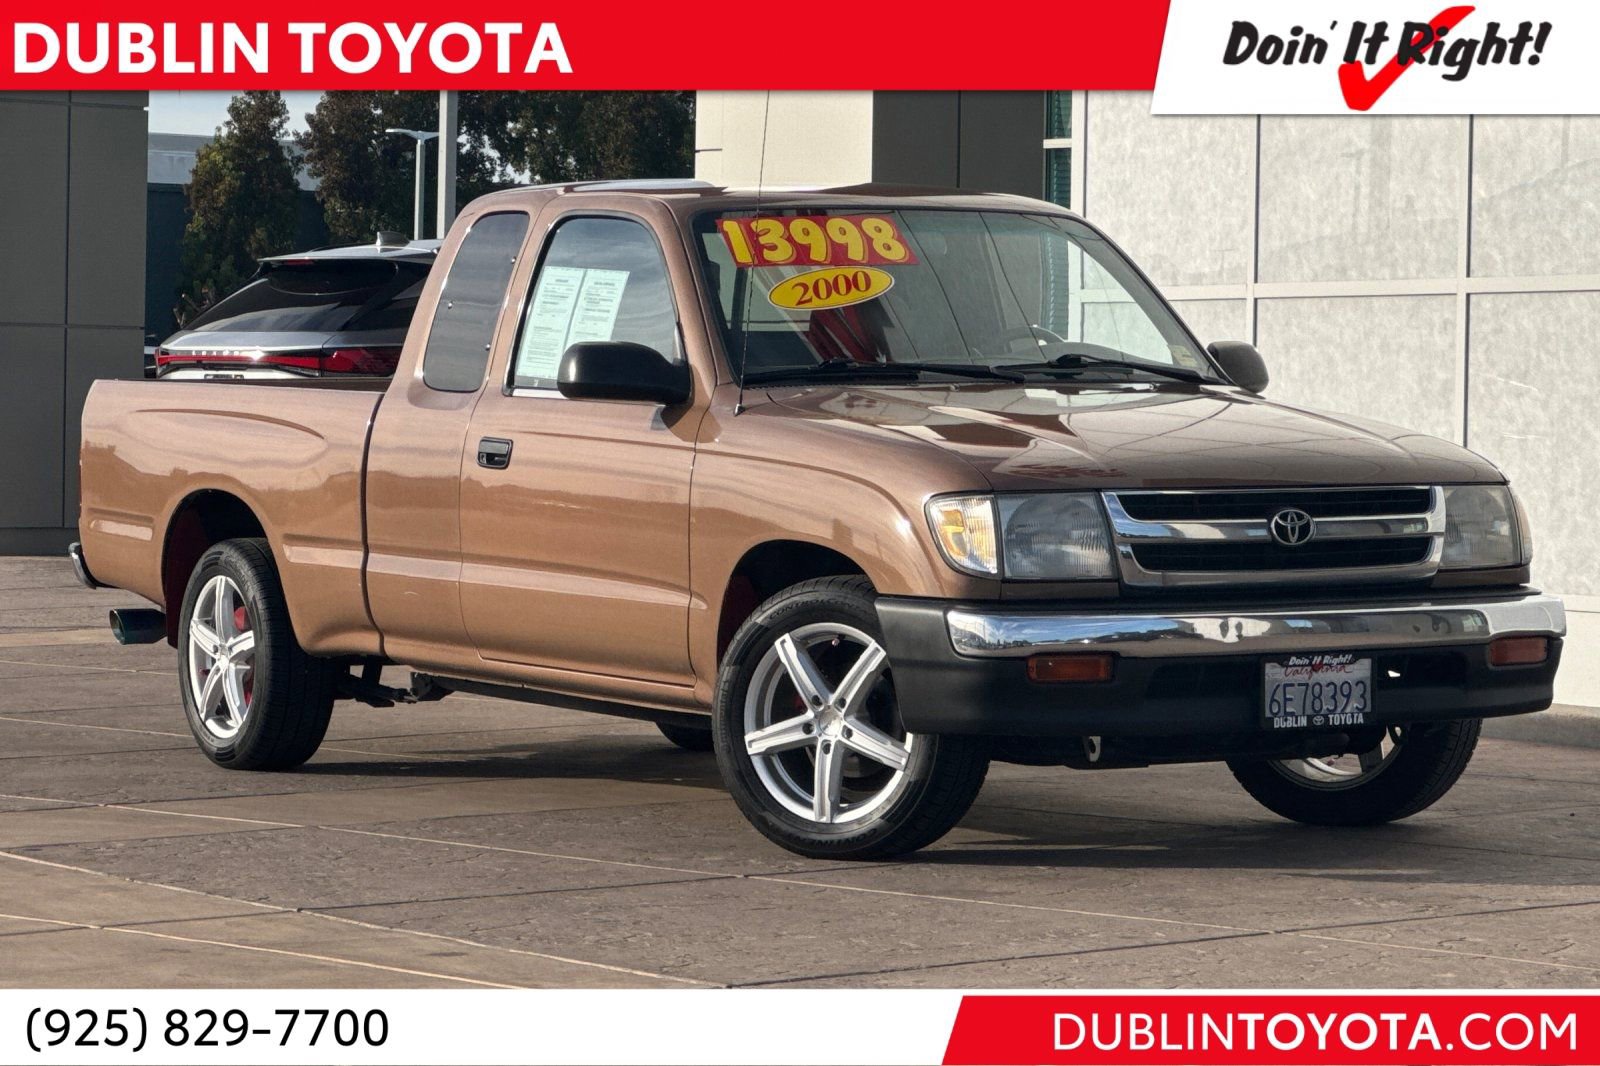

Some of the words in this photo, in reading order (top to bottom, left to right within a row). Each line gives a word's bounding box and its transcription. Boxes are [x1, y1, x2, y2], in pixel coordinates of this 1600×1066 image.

[722, 217, 910, 264] 13998
[791, 270, 872, 307] 2000
[1312, 655, 1323, 665] It
[1322, 653, 1353, 666] Right!
[1268, 680, 1368, 717] 6E78393
[1273, 715, 1308, 729] DUBLIN
[1327, 713, 1365, 726] TOYOTA
